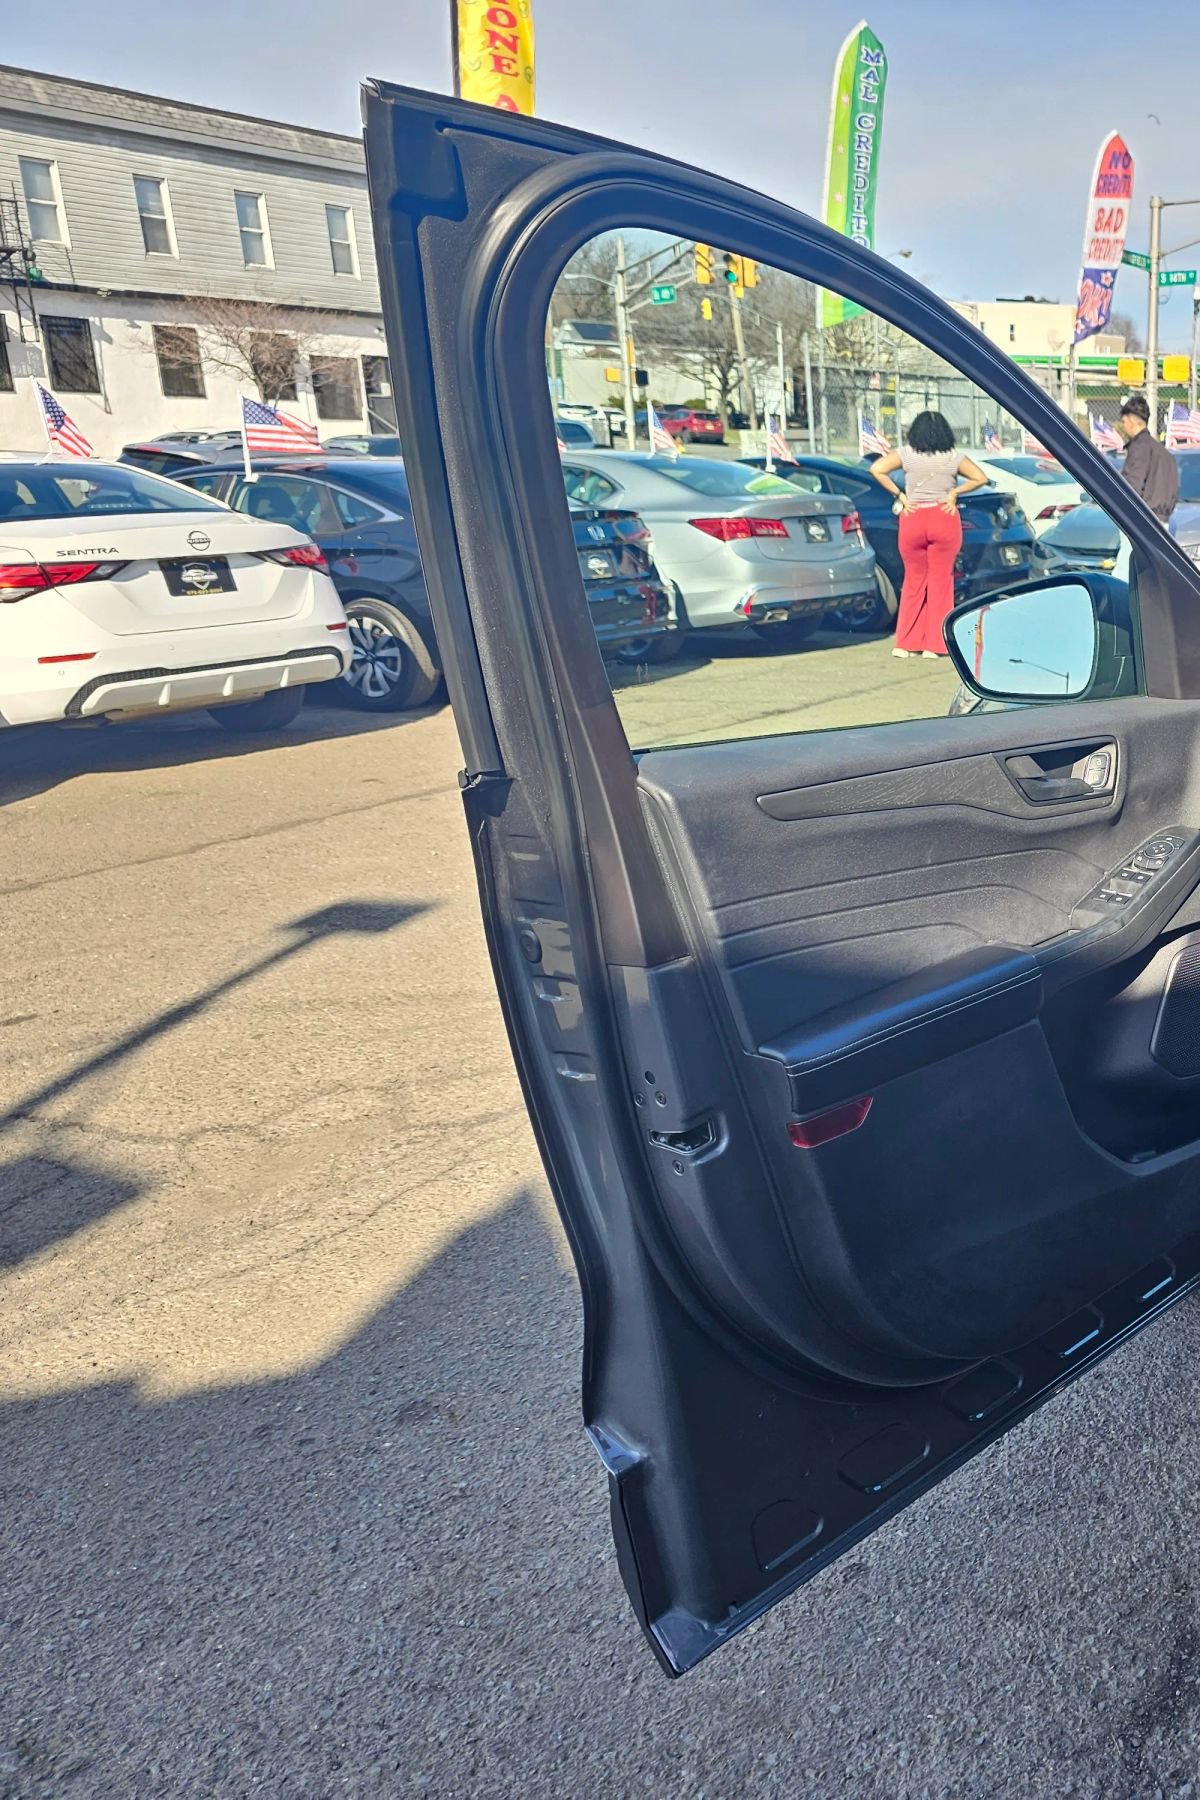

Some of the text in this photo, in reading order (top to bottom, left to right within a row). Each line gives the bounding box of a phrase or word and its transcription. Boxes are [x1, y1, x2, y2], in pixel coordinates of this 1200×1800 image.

[485, 0, 520, 77] ONE
[861, 47, 883, 101] MAL
[1108, 151, 1132, 169] NO
[1094, 207, 1124, 232] BAD
[56, 547, 120, 557] SENTRA
